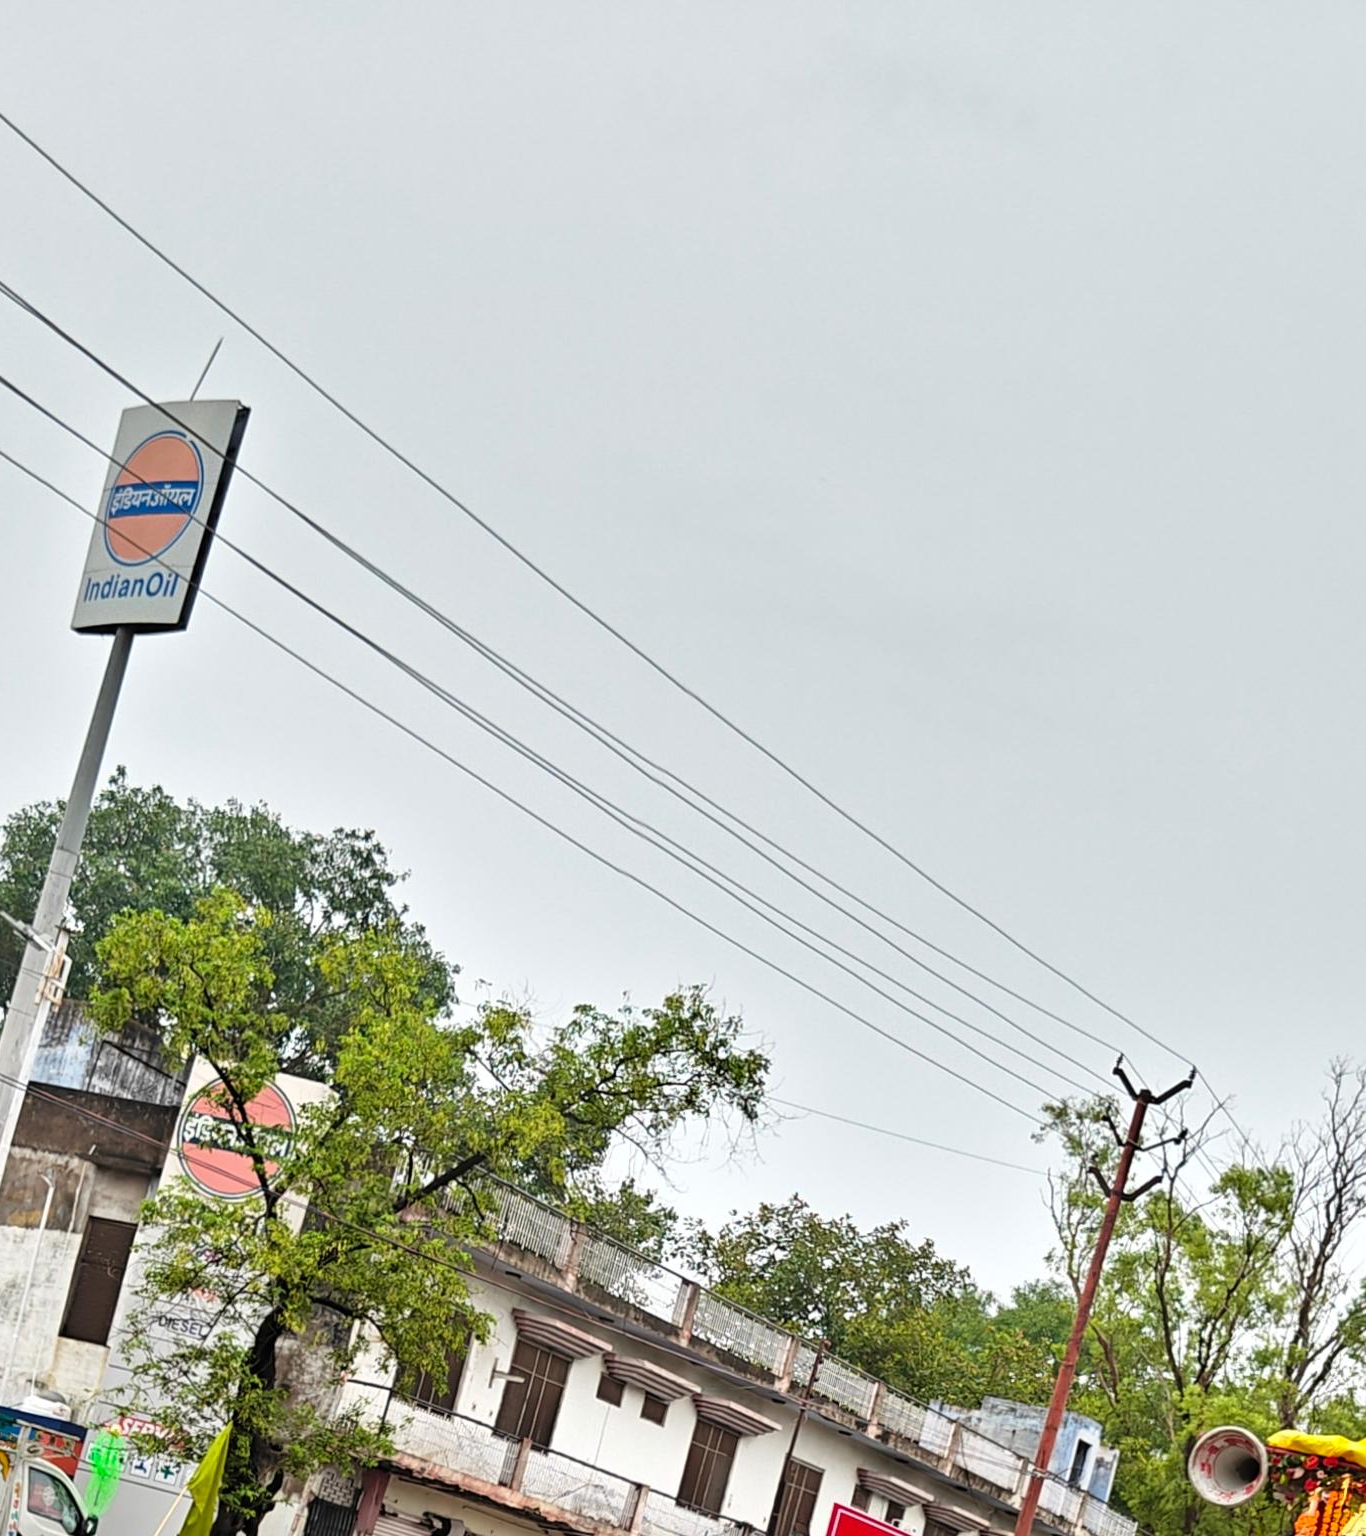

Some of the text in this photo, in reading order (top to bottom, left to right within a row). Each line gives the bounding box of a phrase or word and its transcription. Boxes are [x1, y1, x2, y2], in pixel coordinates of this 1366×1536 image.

[110, 484, 195, 514] इंडियनऑयल
[83, 572, 179, 603] IndianOil
[159, 1316, 207, 1338] DIESEL
